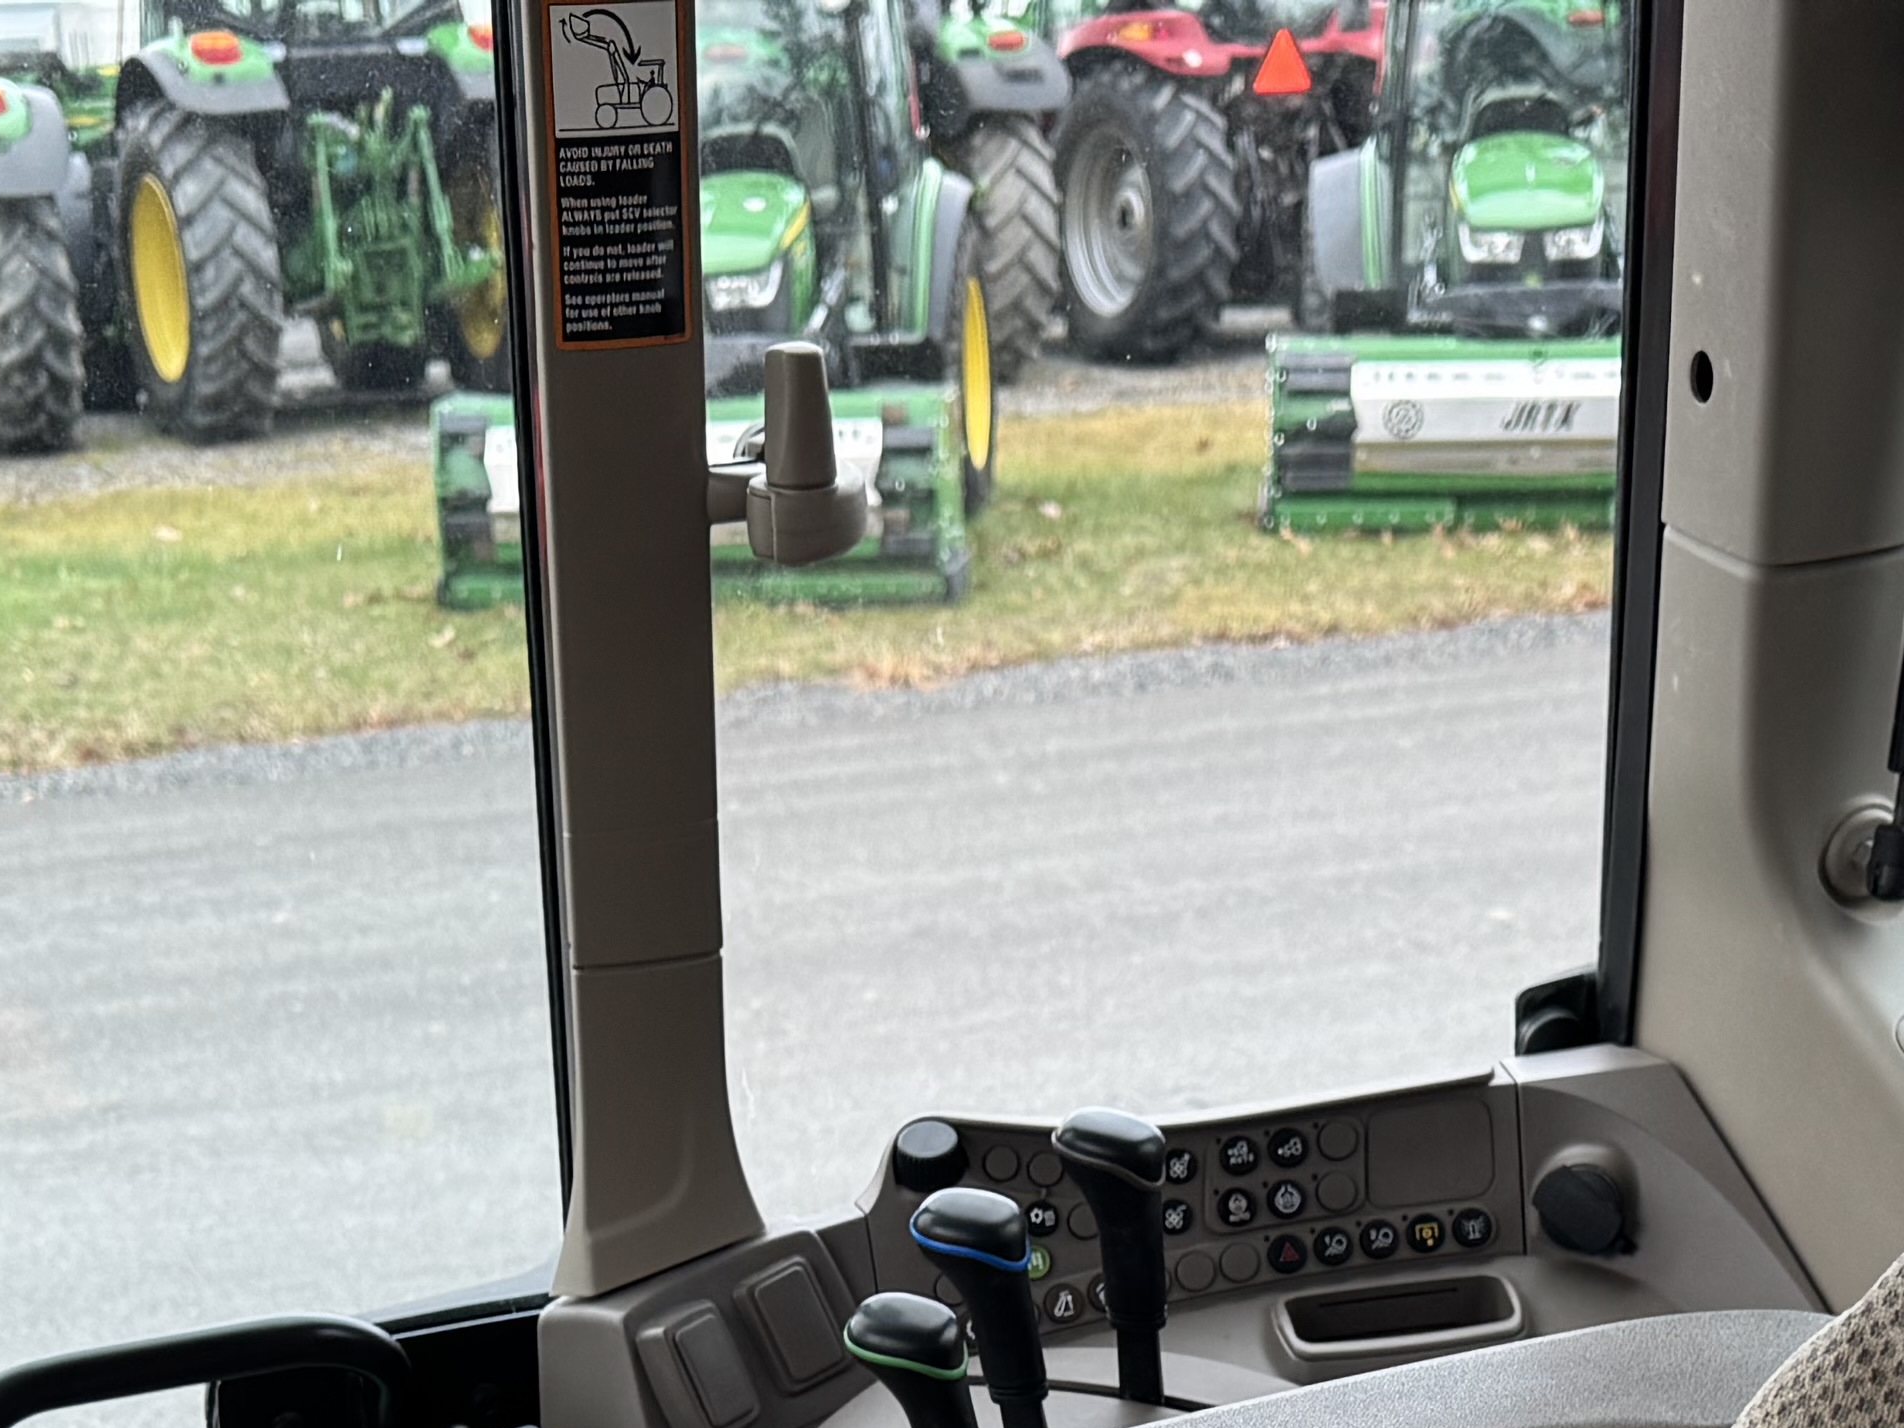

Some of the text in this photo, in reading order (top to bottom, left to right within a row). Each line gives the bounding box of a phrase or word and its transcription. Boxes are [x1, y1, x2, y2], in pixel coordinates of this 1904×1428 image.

[559, 141, 673, 159] AVOID INJURY OR DEATH
[559, 157, 654, 173] CAUSED BY FALLING
[559, 175, 595, 187] LOADS.
[561, 193, 648, 209] When using loader
[562, 209, 602, 222] ALWAYS
[604, 209, 620, 222] put
[562, 224, 592, 236] knobs
[573, 247, 590, 259] you
[592, 245, 604, 256] do
[627, 242, 656, 254] loader
[563, 255, 667, 271] continue to move after
[563, 272, 603, 284] controls
[605, 272, 621, 284] are
[565, 294, 583, 306] See
[631, 288, 665, 302] manual
[566, 302, 662, 319] for use of other knob
